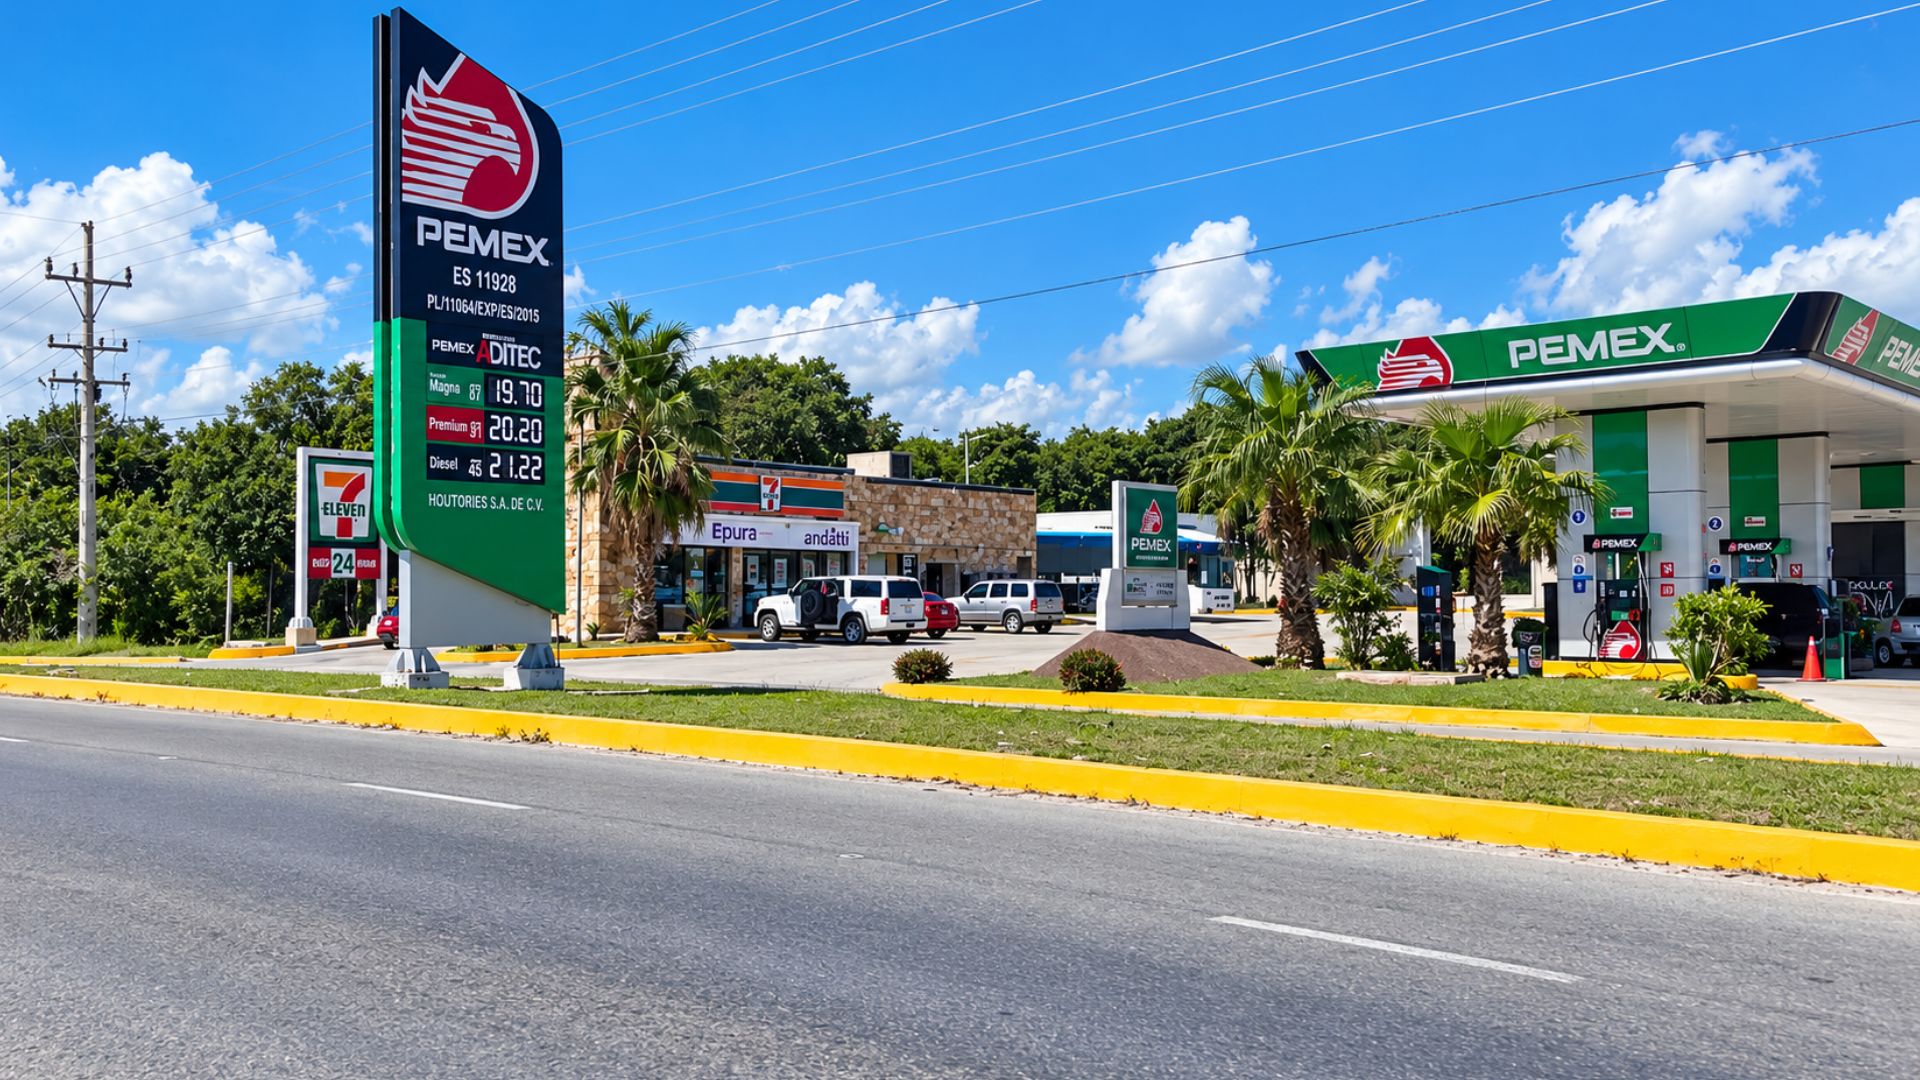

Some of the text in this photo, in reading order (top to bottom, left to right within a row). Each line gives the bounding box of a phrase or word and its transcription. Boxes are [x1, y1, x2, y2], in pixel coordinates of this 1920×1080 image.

[416, 215, 550, 267] PEMEX
[453, 266, 517, 293] ES 11928
[427, 294, 540, 323] PL/11064/EXP/ES/2015
[432, 339, 541, 369] PEMEX ADITEC
[1507, 322, 1676, 369] PEMEX
[1877, 335, 1920, 378] PEME
[429, 379, 461, 396] Magna
[496, 379, 542, 407] 19.70
[429, 417, 468, 432] Premium
[489, 415, 542, 443] 20.20
[429, 456, 458, 470] Diesel
[489, 452, 542, 480] 21.22
[428, 493, 544, 511] HOUTORIES S.A. DE C.V.
[712, 523, 757, 543] Epura
[1131, 537, 1172, 552] PEMEX
[1602, 538, 1638, 548] PEMEX
[333, 553, 355, 574] 24
